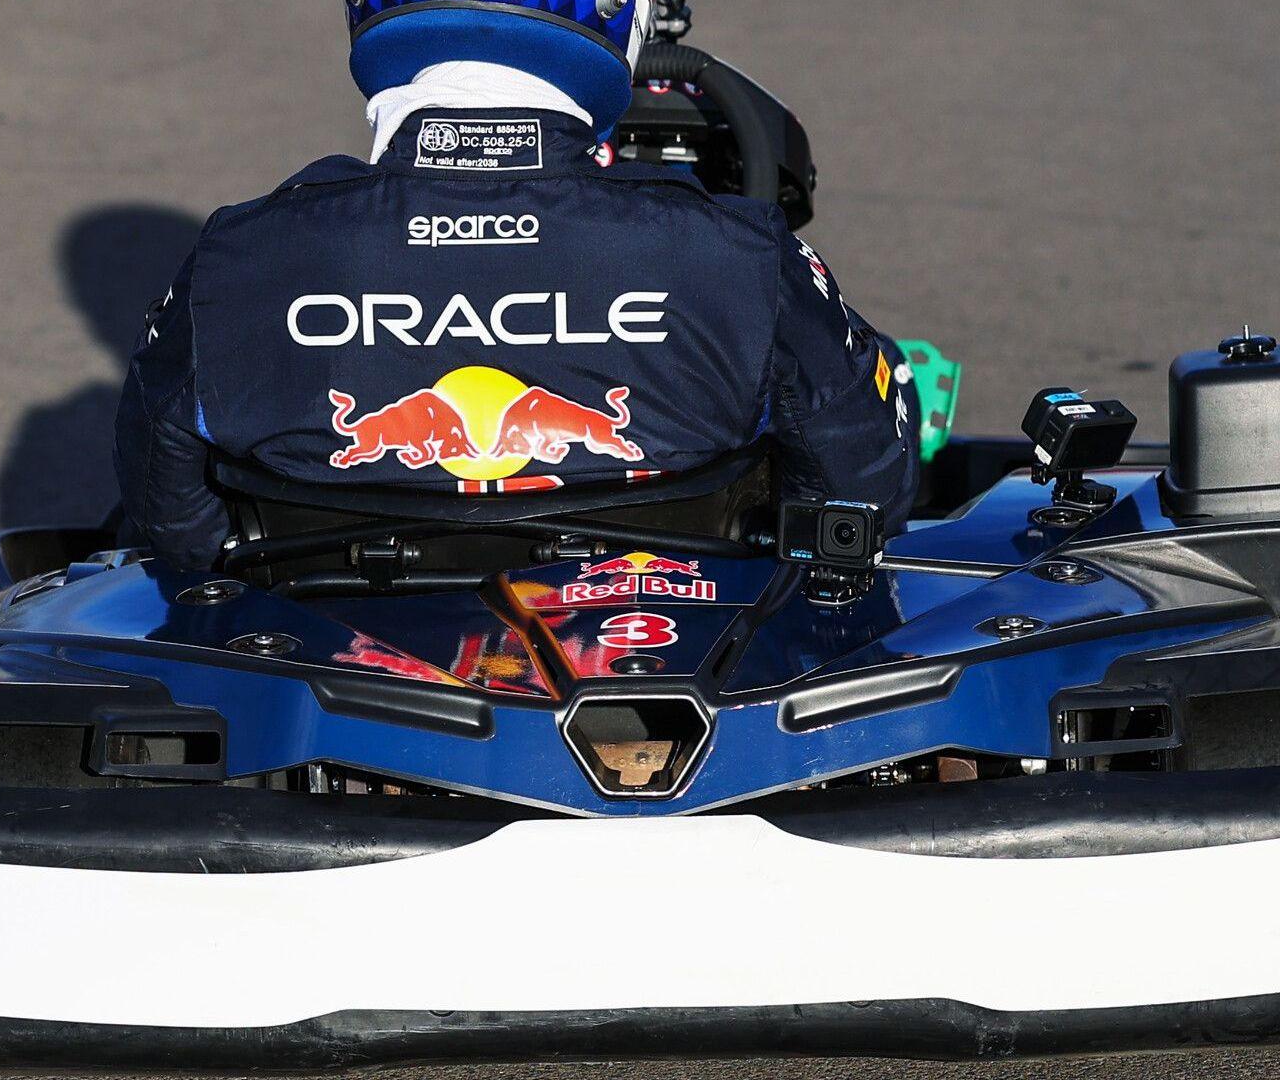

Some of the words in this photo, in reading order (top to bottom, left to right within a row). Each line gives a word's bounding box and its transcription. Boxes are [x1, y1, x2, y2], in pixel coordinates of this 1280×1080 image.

[459, 124, 494, 134] Standard
[407, 214, 540, 247] sparco
[286, 291, 669, 347] ORACLE
[562, 574, 640, 604] Red
[642, 575, 716, 601] Bull
[596, 611, 679, 649] 3
